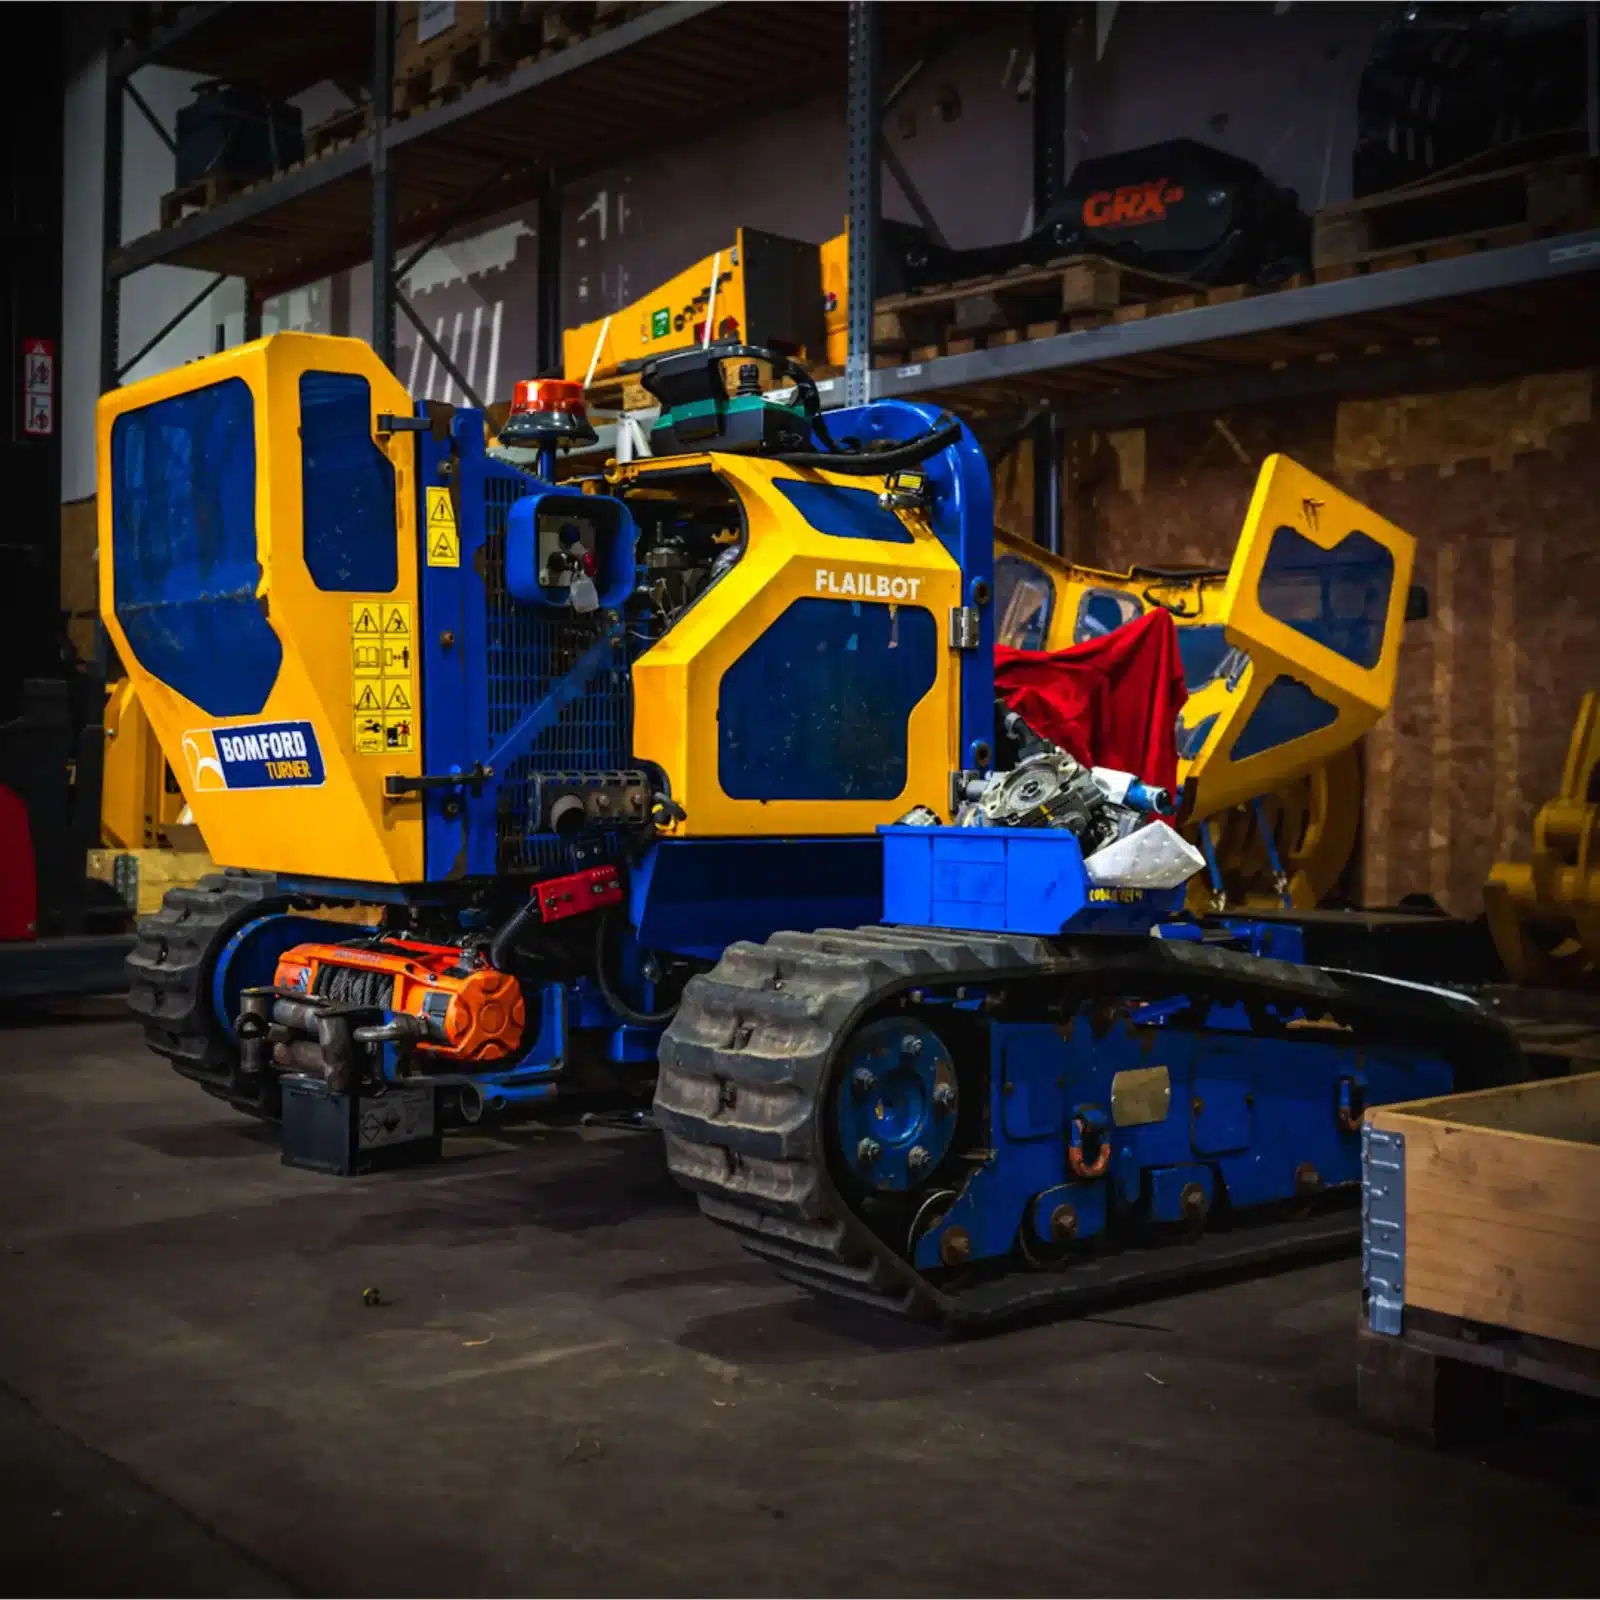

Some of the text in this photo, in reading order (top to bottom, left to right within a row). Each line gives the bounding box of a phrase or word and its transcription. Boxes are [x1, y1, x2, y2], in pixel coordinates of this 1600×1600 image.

[1082, 179, 1168, 228] GRX
[815, 568, 921, 601] FLAILBOT
[219, 730, 308, 763] BOMFORD
[265, 760, 312, 780] TURNER
